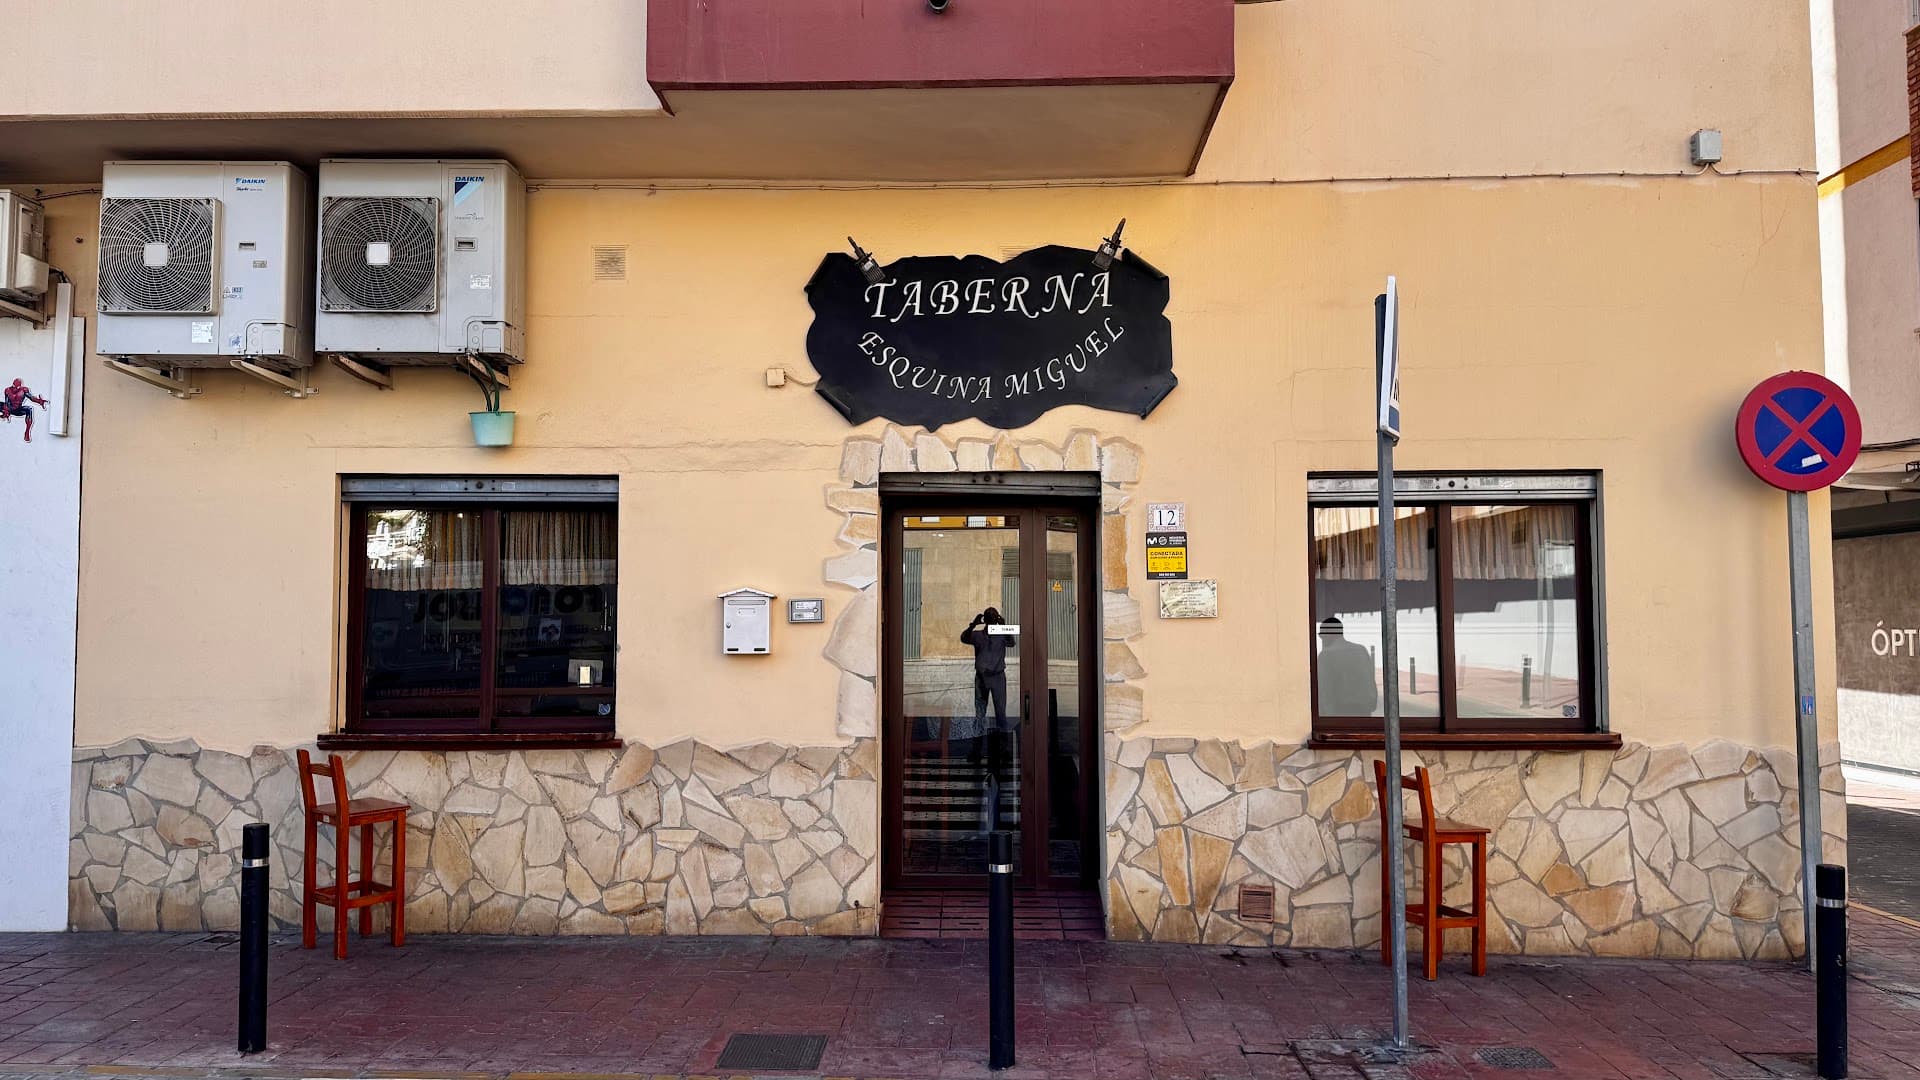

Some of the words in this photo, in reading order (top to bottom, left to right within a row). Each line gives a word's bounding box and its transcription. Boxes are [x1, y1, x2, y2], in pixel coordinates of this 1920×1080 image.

[864, 271, 1113, 323] TABERNA
[857, 331, 993, 403] ESQUINA
[1004, 317, 1125, 399] MIGUEL
[1158, 510, 1176, 526] 12
[1871, 620, 1920, 657] ÓPT
